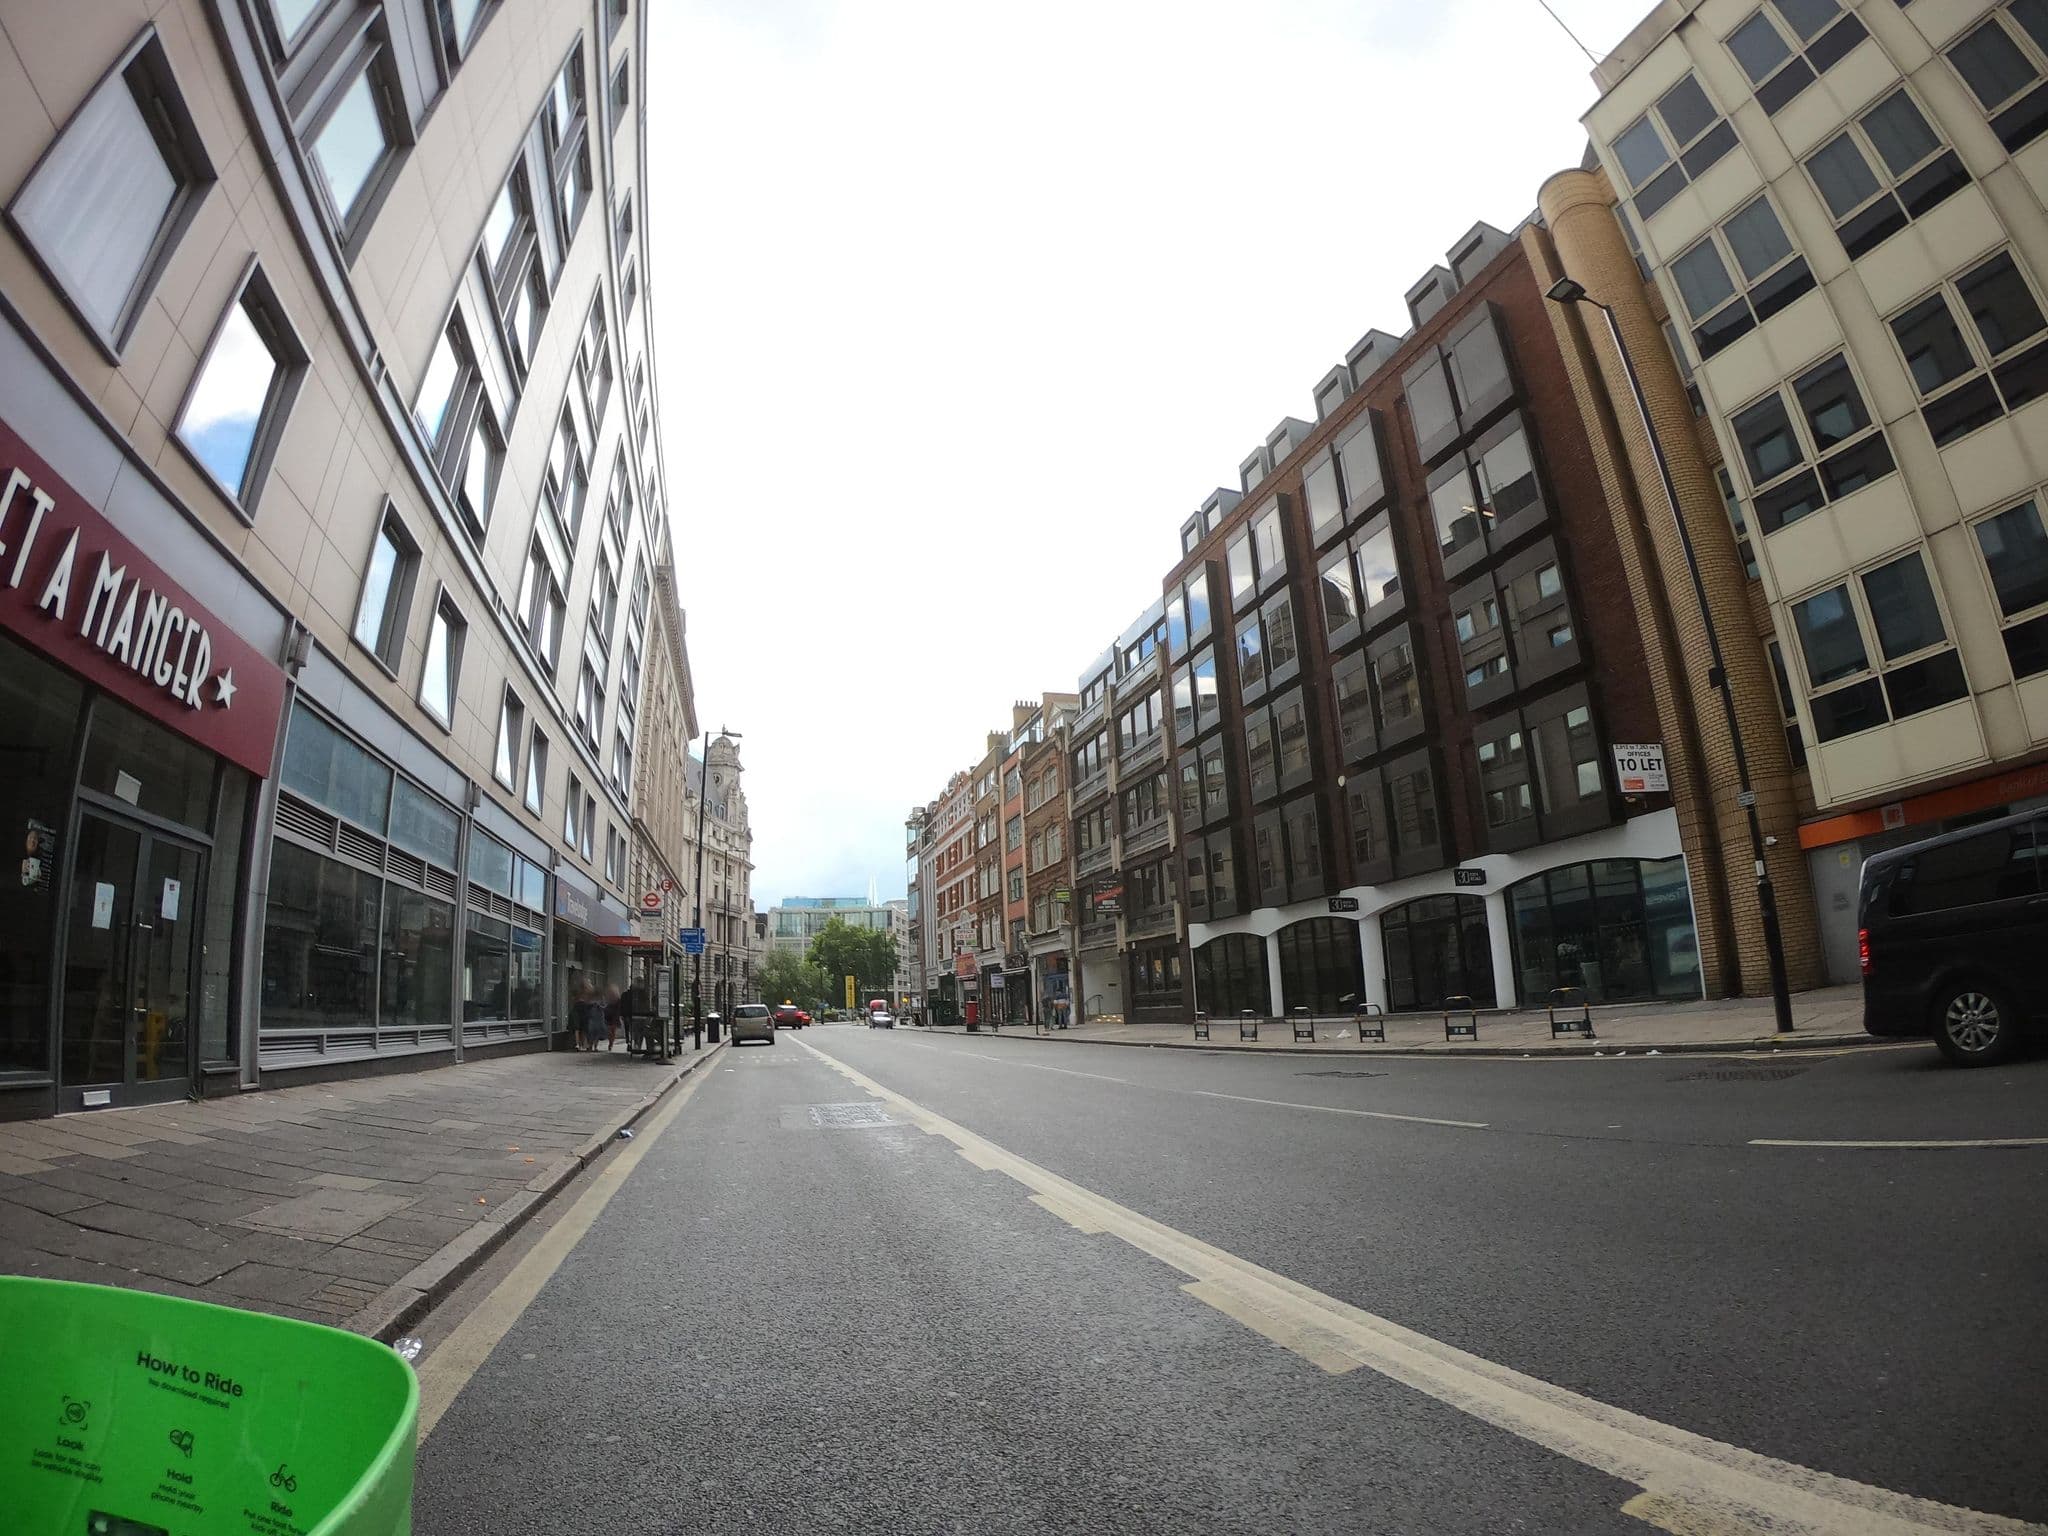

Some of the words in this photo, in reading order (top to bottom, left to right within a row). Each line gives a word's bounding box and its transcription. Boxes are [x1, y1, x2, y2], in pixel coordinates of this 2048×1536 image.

[40, 526, 80, 621] A
[81, 549, 211, 711] MANGER
[1618, 758, 1637, 771] TO
[1640, 758, 1662, 771] LET
[664, 880, 671, 889] E
[1457, 871, 1470, 883] 30
[1331, 899, 1343, 910] 30
[137, 1350, 178, 1376] How
[182, 1365, 200, 1384] to
[205, 1370, 243, 1397] Ride
[56, 1435, 84, 1452] Look
[166, 1467, 193, 1485] Hold
[269, 1500, 293, 1518] Ride
